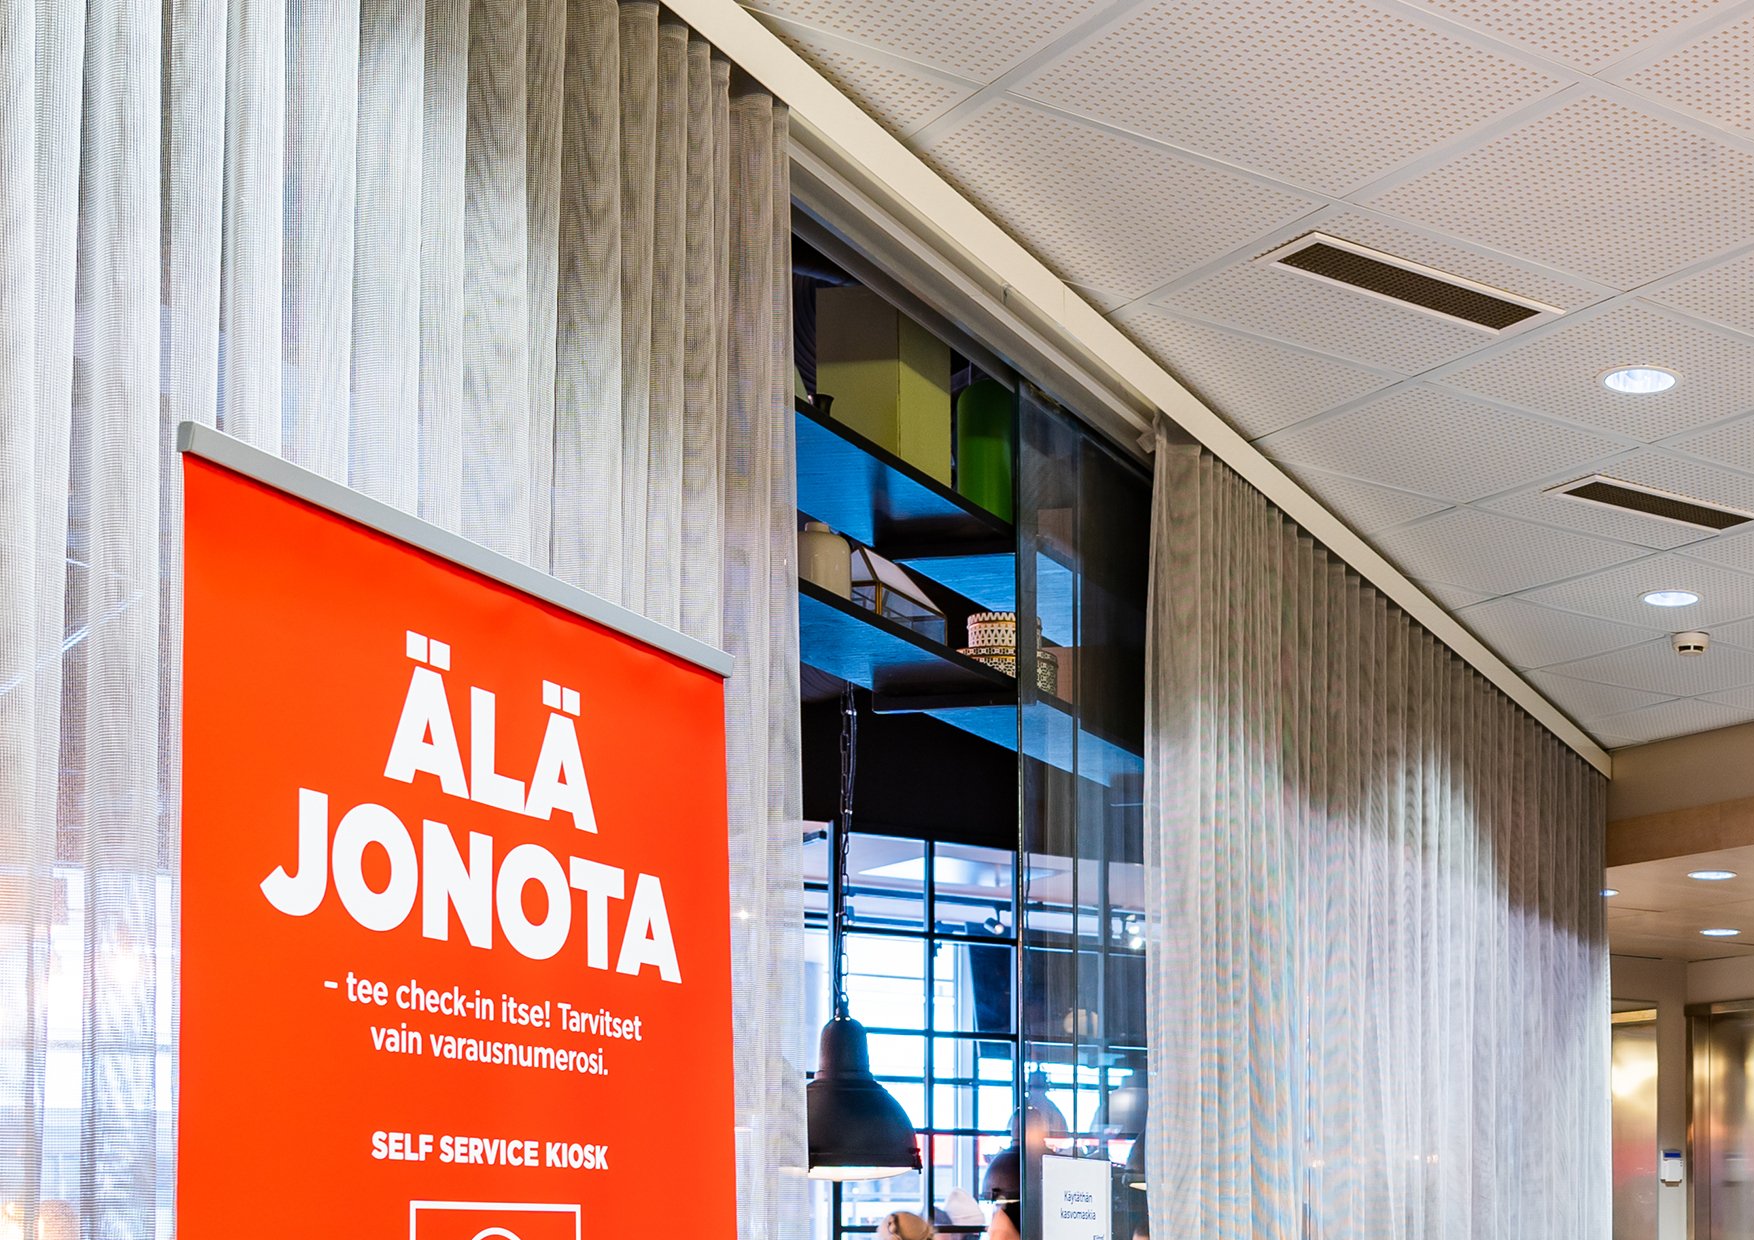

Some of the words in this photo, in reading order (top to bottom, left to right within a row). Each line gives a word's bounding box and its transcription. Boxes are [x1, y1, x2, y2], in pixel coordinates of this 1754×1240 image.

[384, 630, 598, 834] ÄLÄ
[259, 787, 682, 984] JONOTA
[346, 971, 388, 1007] tee
[396, 979, 495, 1021] check-in
[501, 993, 551, 1029] itse!
[557, 1001, 643, 1042] Tarvitset
[371, 1024, 422, 1056] vain
[430, 1031, 610, 1077] varausnumerosi.
[371, 1131, 433, 1162] SELF
[439, 1135, 539, 1167] SERVICE
[545, 1142, 609, 1170] KIOSK
[1060, 1207, 1097, 1221] kasvomaskia
[1063, 1190, 1093, 1205] Käytäthän
